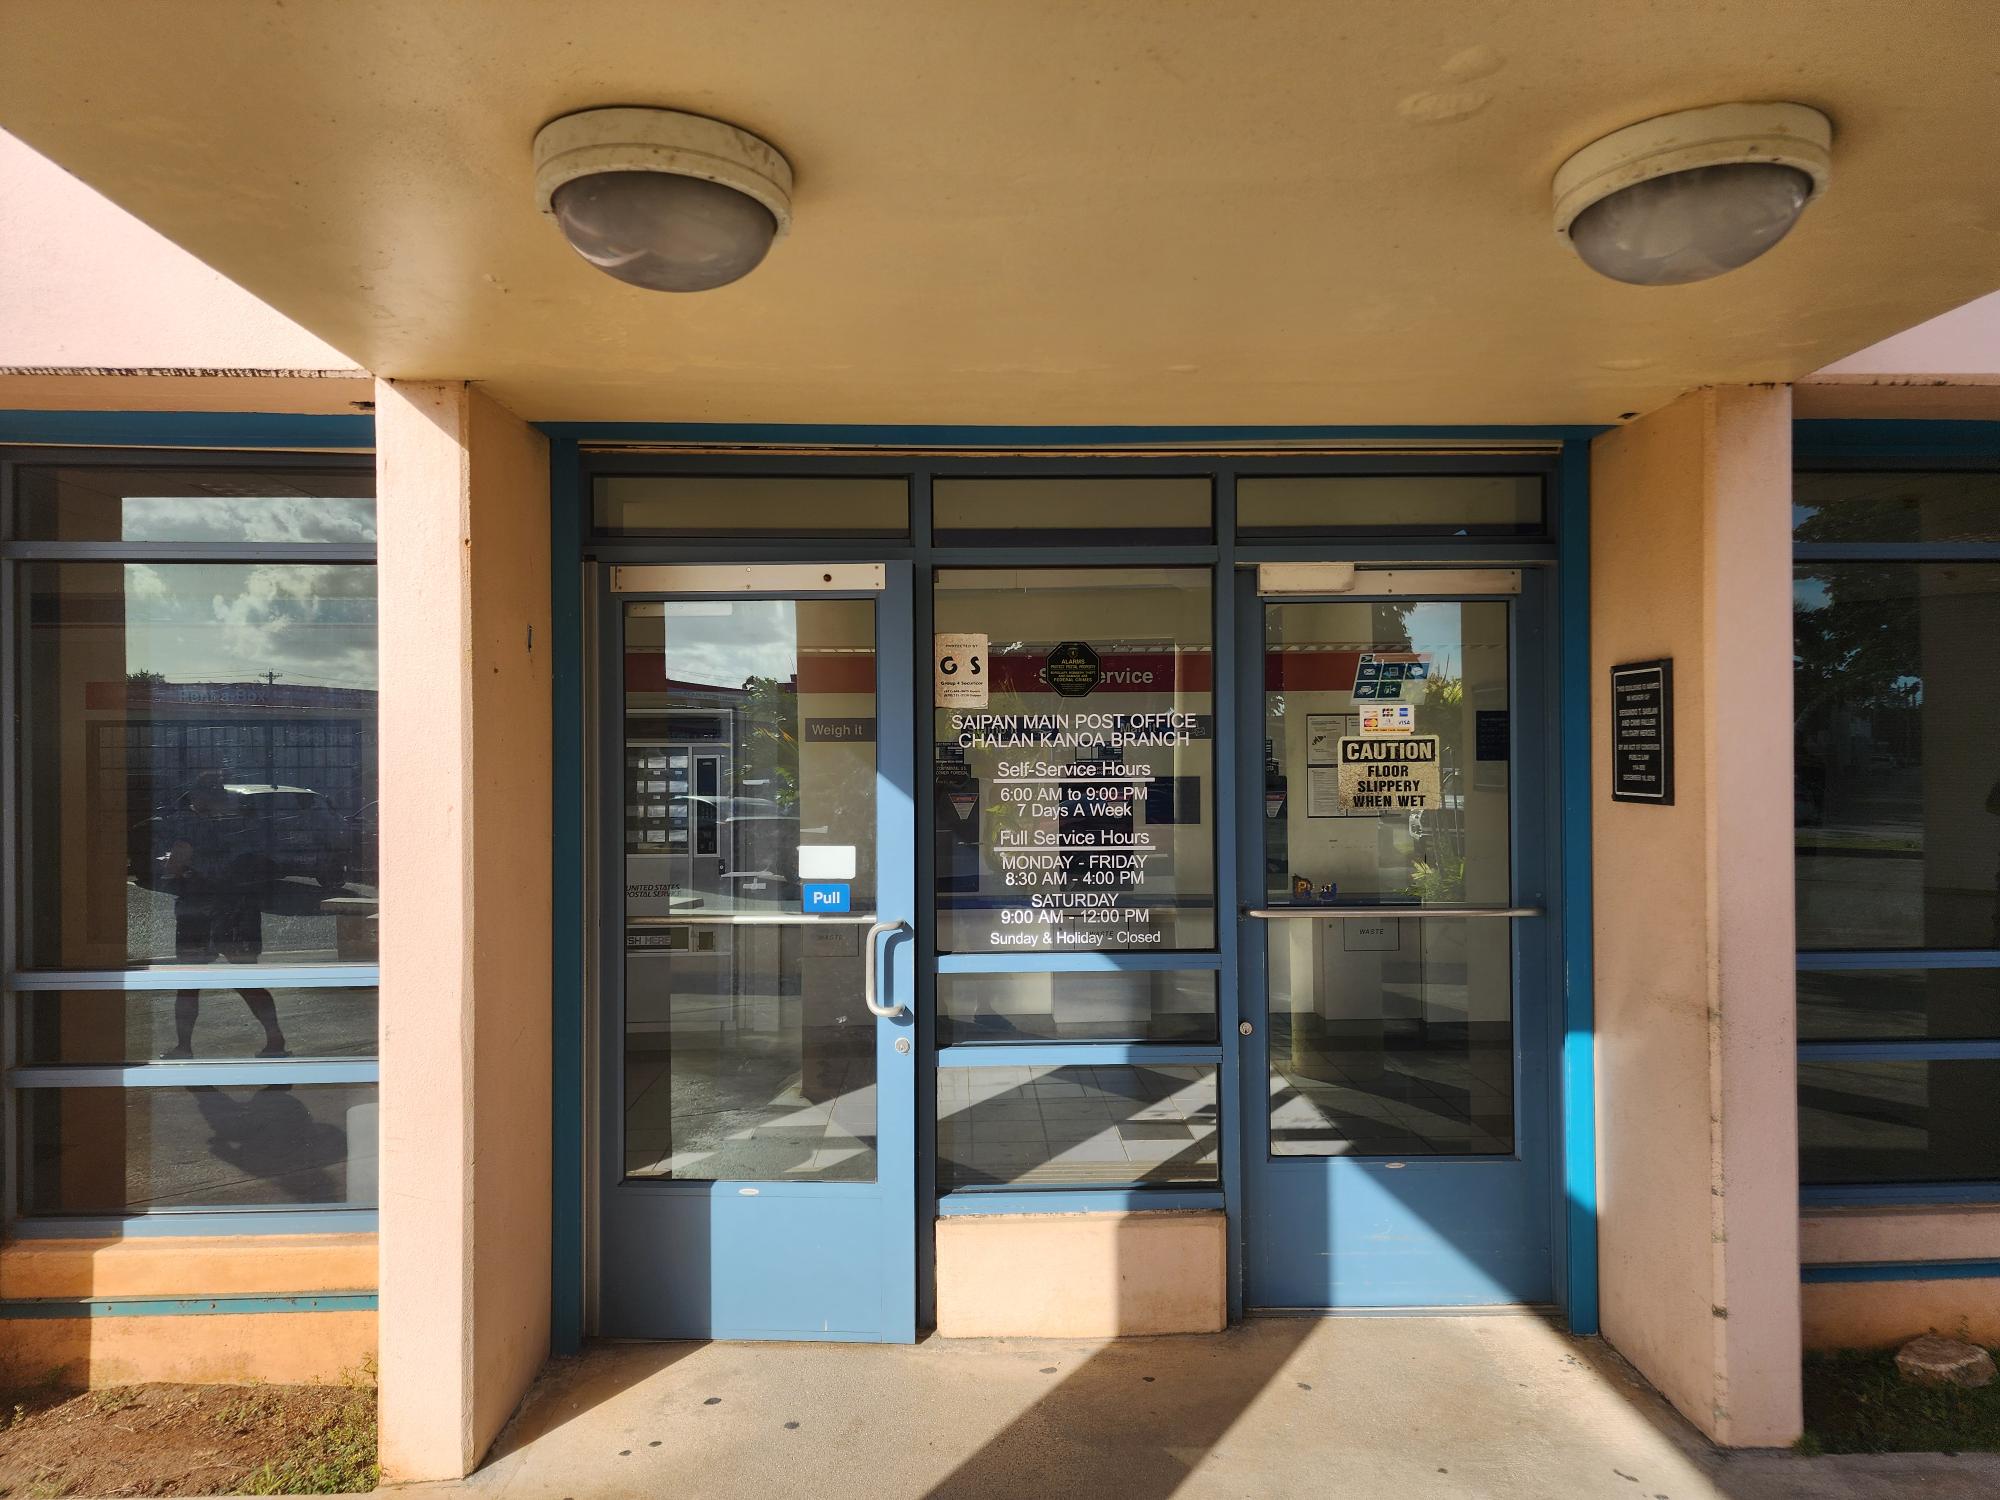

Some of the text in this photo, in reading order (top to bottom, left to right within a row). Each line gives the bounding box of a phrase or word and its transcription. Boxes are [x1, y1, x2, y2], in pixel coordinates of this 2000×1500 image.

[952, 713, 1196, 730] SAIPAN MAIN POST OFFICE
[812, 724, 863, 738] Weigh it
[958, 732, 1190, 748] CHALAN KANOA BRANCH
[1346, 742, 1433, 760] CAUTION
[998, 762, 1151, 778] Self-Service Hours
[1368, 765, 1409, 778] FLOOR
[1000, 786, 1148, 802] 6:00 AM to 9:00 PM
[1357, 780, 1420, 792] SLIPPERY
[1354, 796, 1426, 808] WHEN WET
[1016, 803, 1132, 820] 7 Days A Week
[1000, 830, 1150, 846] Full Service Hours
[1002, 855, 1074, 870] MONDAY
[1089, 854, 1148, 869] FRIDAY
[1006, 872, 1037, 886] 8:30
[1042, 871, 1068, 885] AM
[1082, 871, 1115, 885] 4:00
[1120, 870, 1144, 884] PM
[813, 891, 840, 905] Pull
[1032, 893, 1120, 908] SATURDAY
[1001, 910, 1034, 924] 9:00
[1038, 910, 1064, 924] AM
[1081, 910, 1120, 924] 12:00
[1124, 909, 1150, 923] PM
[990, 932, 1038, 948] Sunday
[1042, 932, 1052, 944] &
[1056, 931, 1104, 947] Holiday
[1116, 930, 1161, 944] Closed
